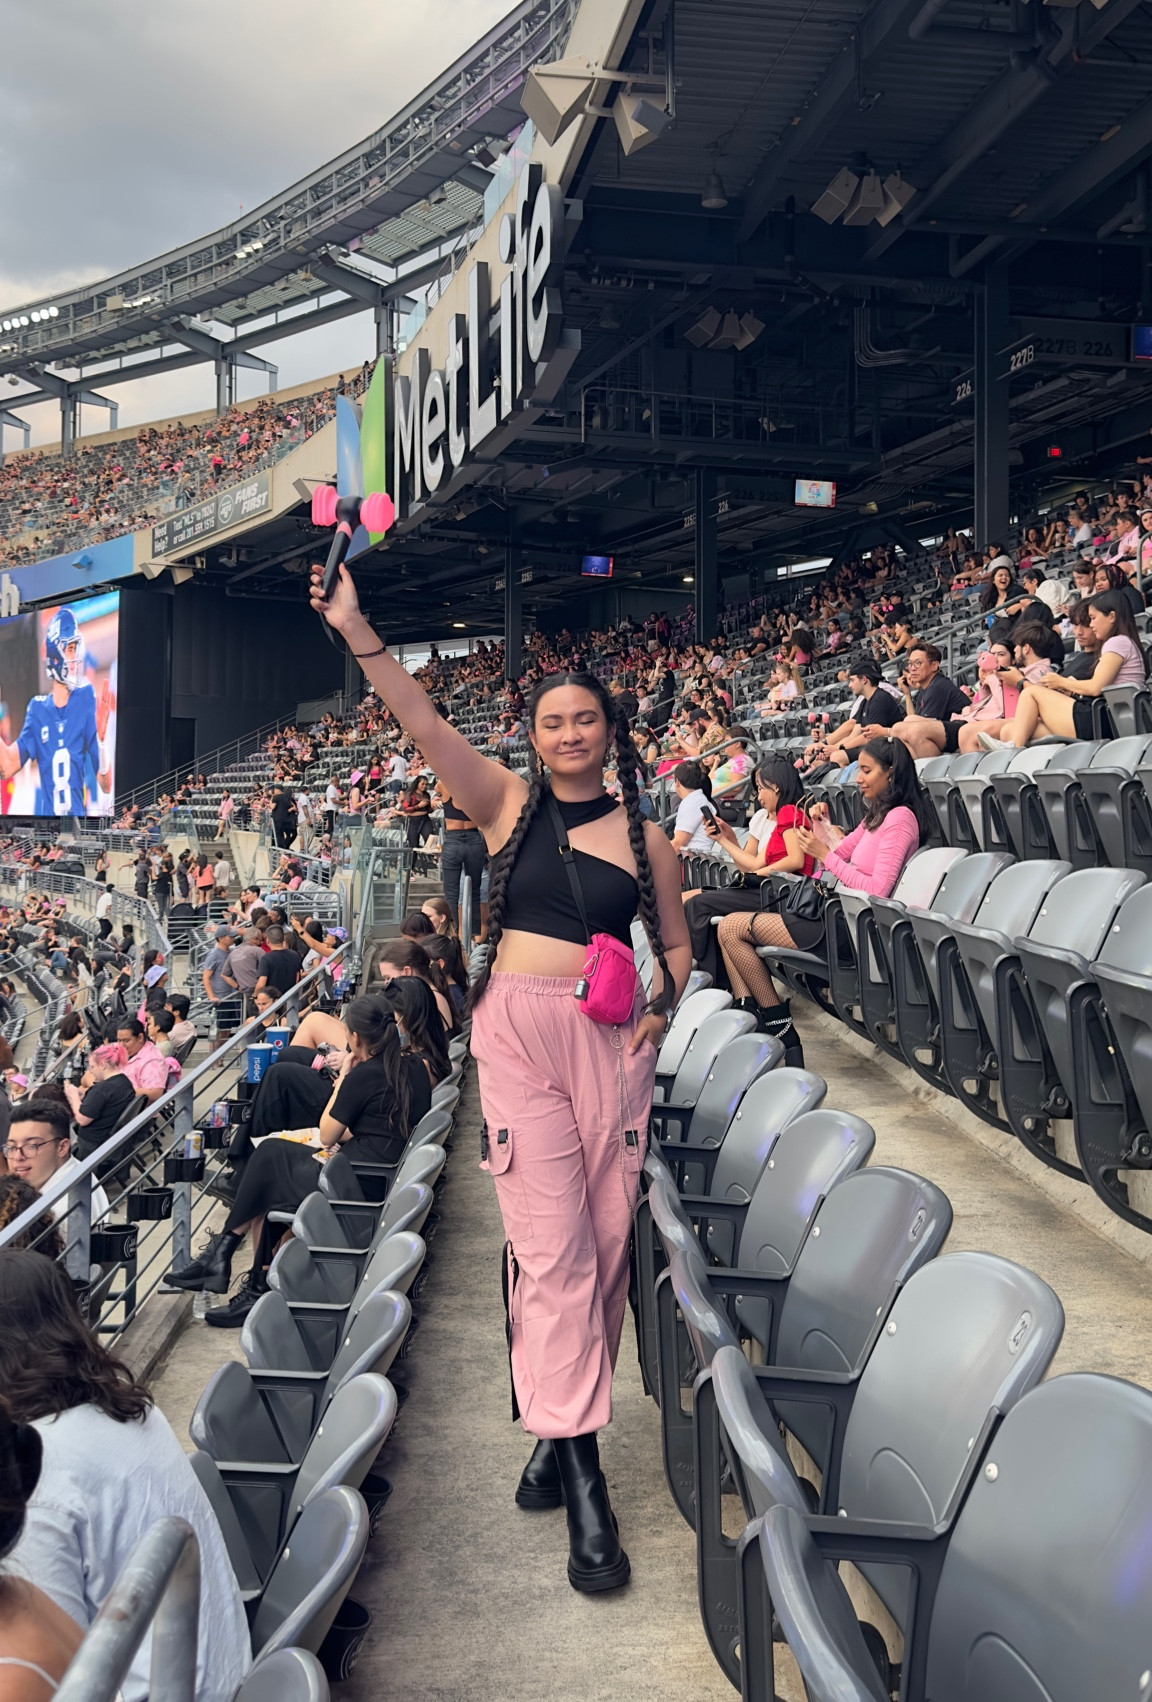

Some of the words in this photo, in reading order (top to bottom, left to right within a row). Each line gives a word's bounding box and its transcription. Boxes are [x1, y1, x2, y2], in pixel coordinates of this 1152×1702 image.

[394, 161, 553, 521] MetLife
[1083, 341, 1113, 357] 226
[1010, 344, 1034, 372] 227B
[956, 380, 972, 401] 226
[235, 483, 259, 505] FANS
[242, 491, 268, 515] FIRST
[154, 523, 168, 539] Need
[52, 747, 72, 816] 8
[253, 1057, 261, 1081] pepsi
